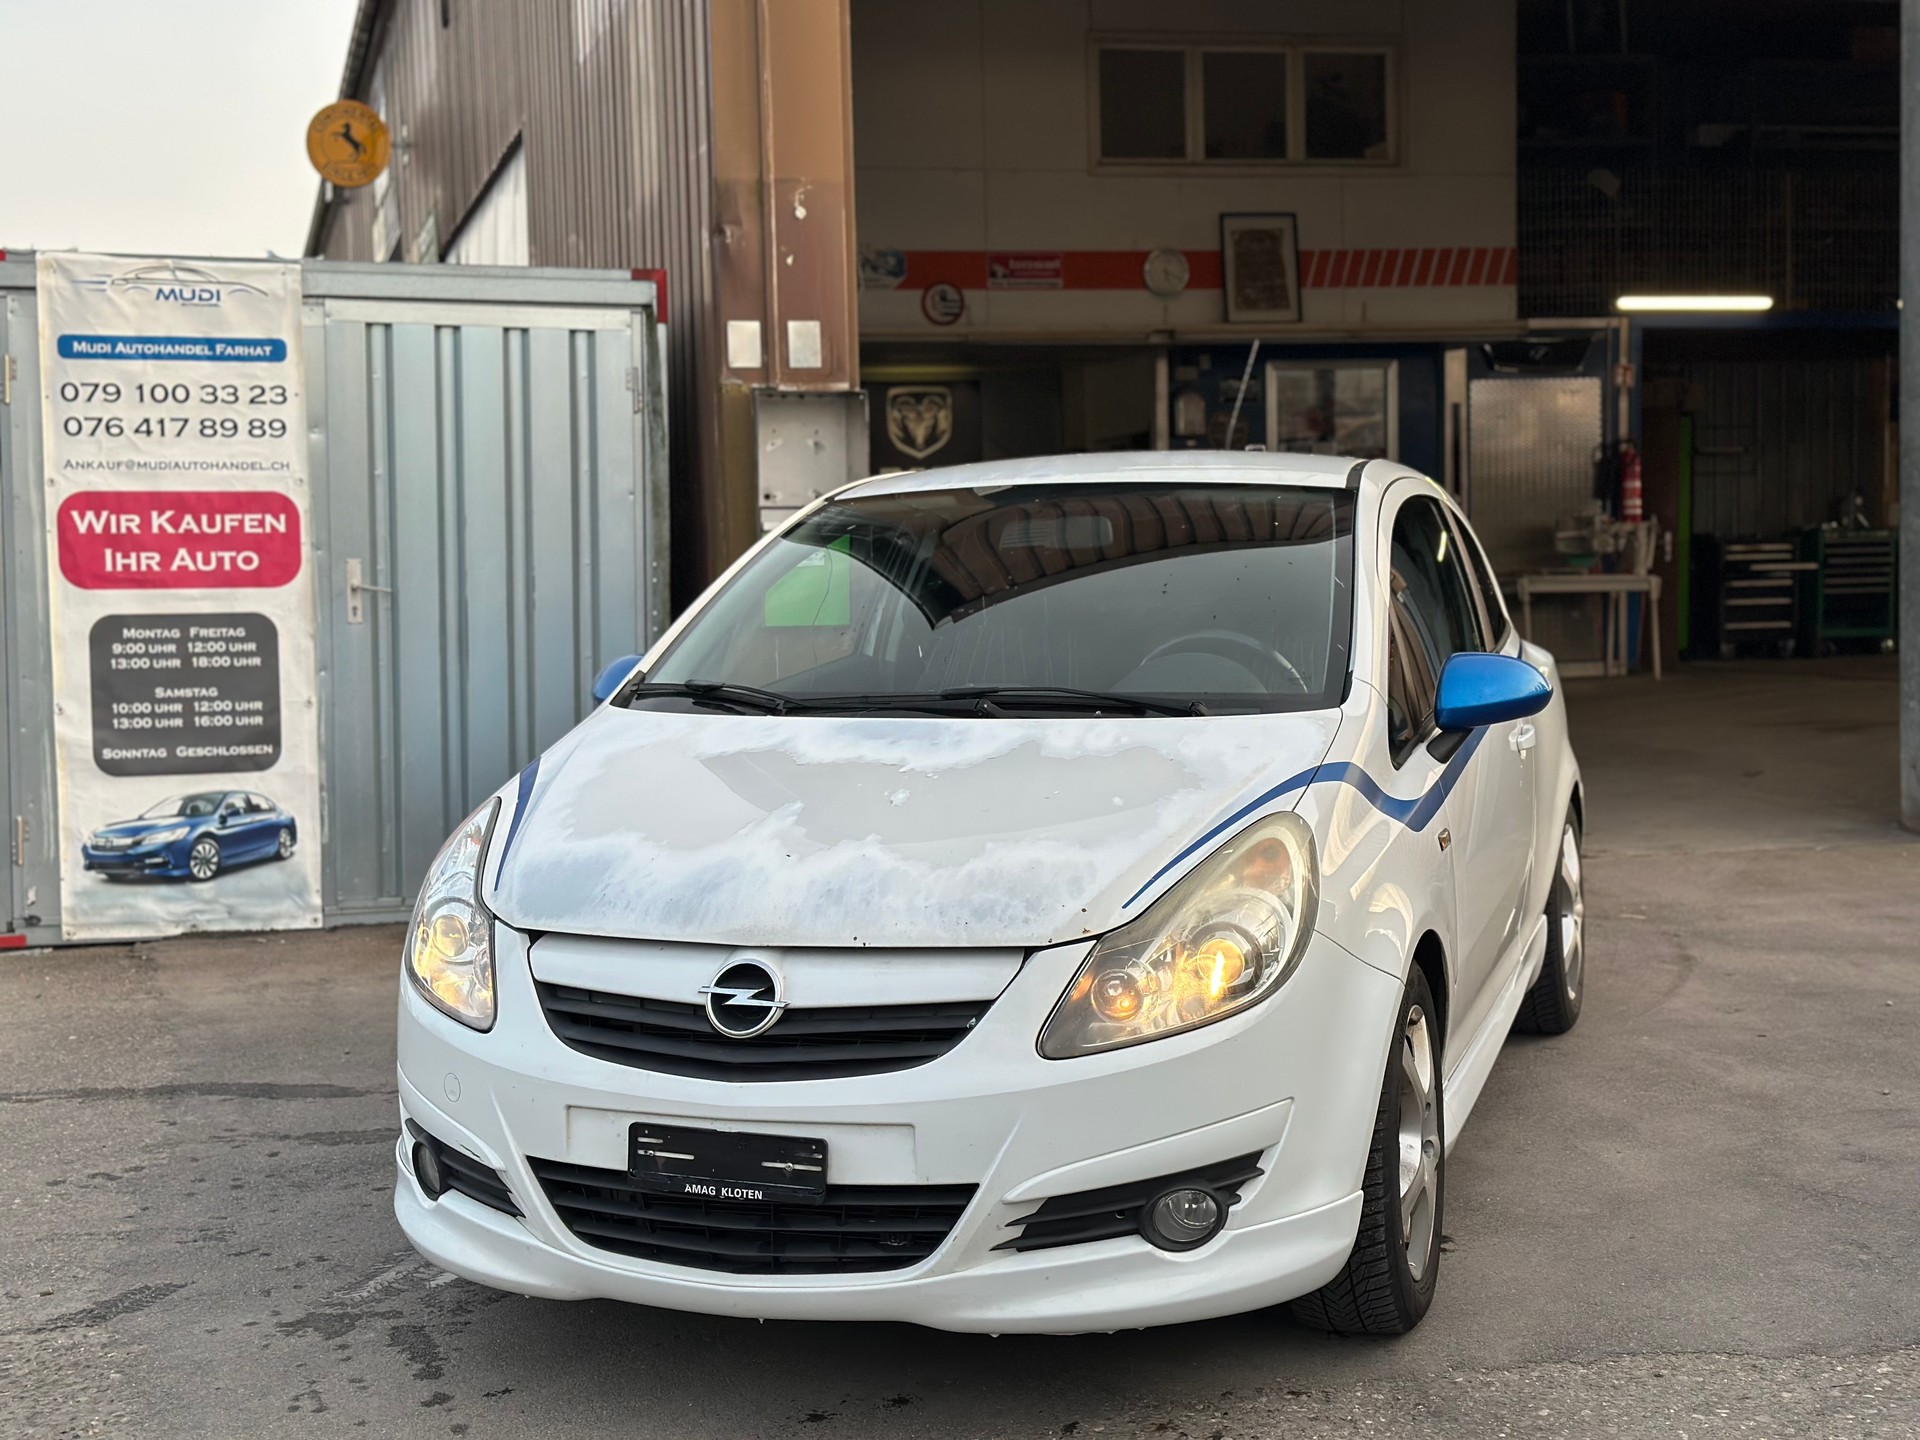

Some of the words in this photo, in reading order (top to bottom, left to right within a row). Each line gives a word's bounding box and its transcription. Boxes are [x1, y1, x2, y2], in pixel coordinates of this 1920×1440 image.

[156, 288, 221, 302] MUDI
[72, 341, 112, 354] MUDI
[115, 342, 213, 356] AUTOHANDEL
[216, 344, 272, 357] FARHAT
[60, 382, 122, 404] 079
[136, 383, 190, 404] 100
[200, 385, 239, 404] 33
[248, 385, 288, 405] 23
[64, 417, 124, 438] 076
[133, 418, 189, 438] 417
[199, 418, 239, 438] 89
[248, 418, 287, 438] 89
[63, 458, 290, 472] ANKAUF@MUDIAUTOHANDEL.CH
[70, 510, 142, 534] WIR
[151, 510, 286, 534] KAUFEN
[104, 548, 160, 572] IHR
[170, 548, 260, 572] AUTO
[122, 627, 181, 639] MONTAG
[190, 626, 246, 638] FREITAG
[112, 642, 146, 654] 9:00
[148, 643, 177, 654] UHR
[187, 642, 225, 653] 12:00
[228, 642, 256, 652] UHR
[110, 658, 150, 670] 13:00
[153, 658, 182, 668] UHR
[192, 656, 230, 668] 18:00
[233, 656, 262, 667] UHR
[154, 686, 218, 698] SAMSTAG
[112, 702, 152, 714] 10:00
[154, 702, 182, 713] UHR
[193, 700, 232, 712] 12:00
[234, 701, 263, 712] UHR
[112, 718, 152, 730] 13:00
[155, 718, 183, 728] UHR
[194, 716, 232, 727] 16:00
[236, 716, 264, 726] UHR
[102, 748, 167, 760] SONNTAG
[176, 745, 273, 758] GESCHLOSSEN
[684, 1182, 717, 1196] AMAG
[721, 1186, 764, 1200] KLOTEN
